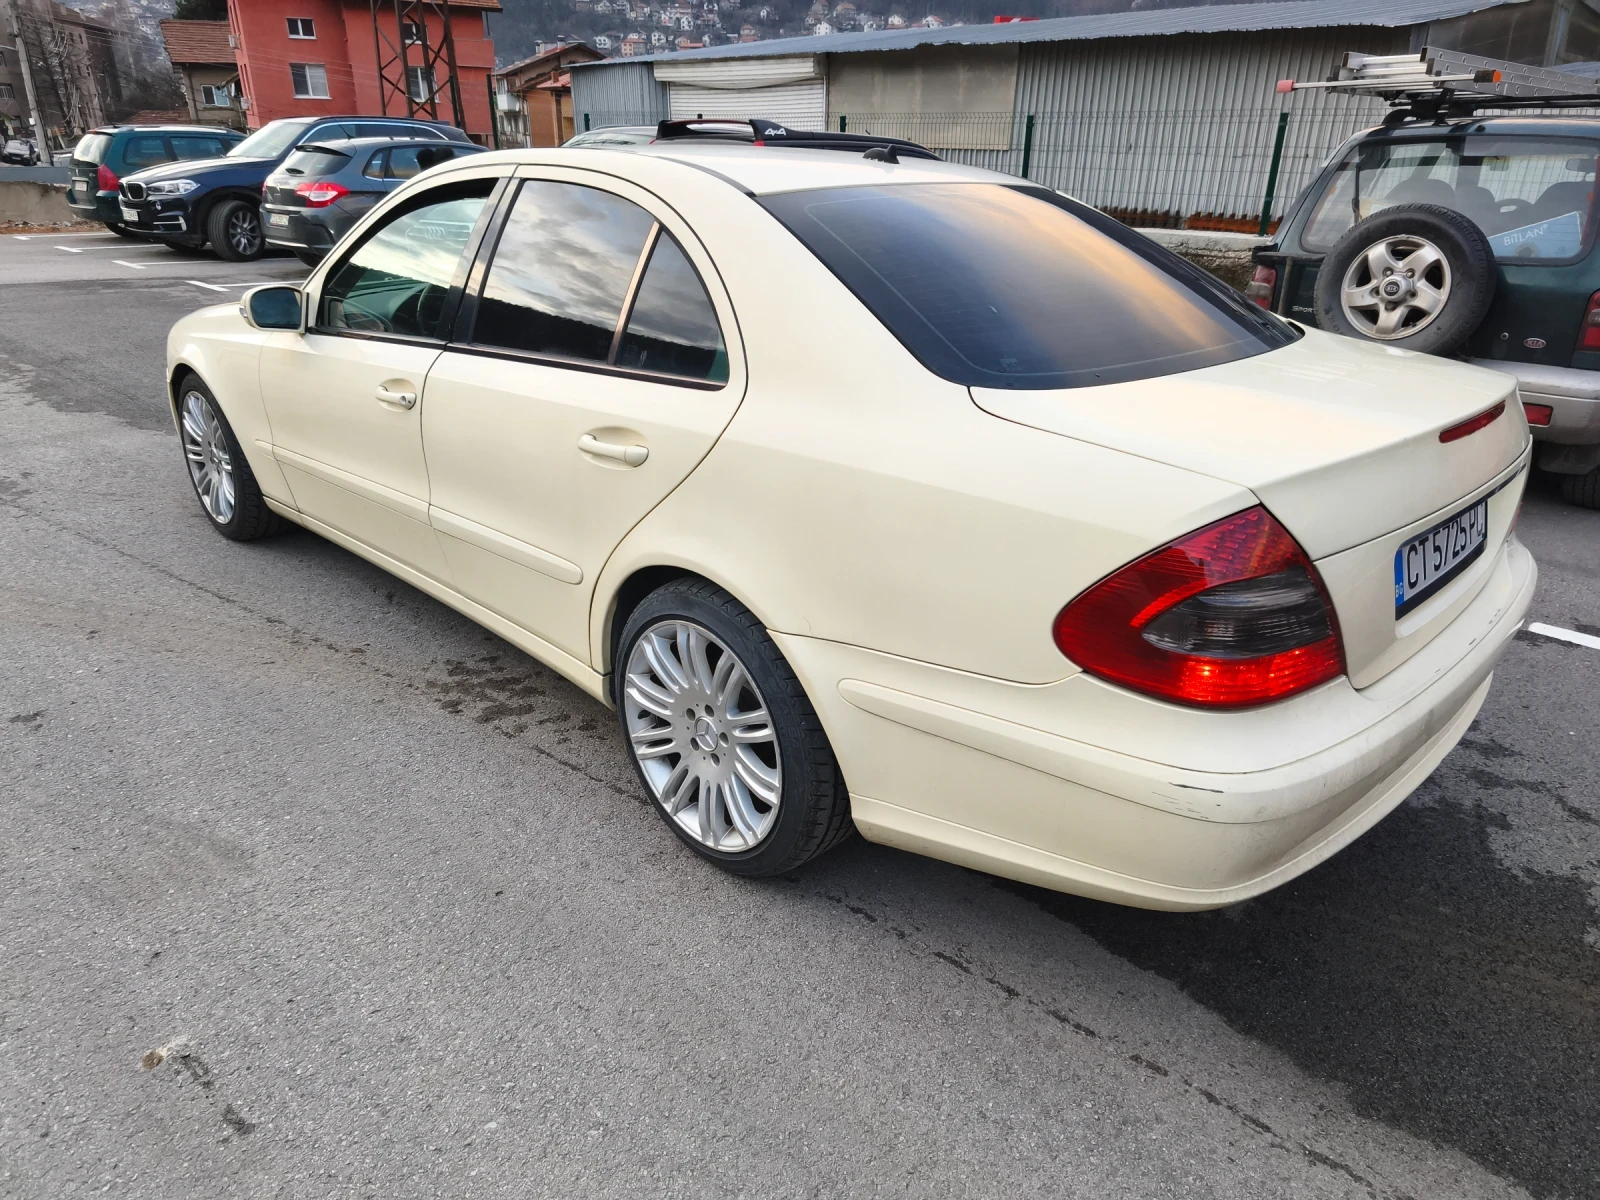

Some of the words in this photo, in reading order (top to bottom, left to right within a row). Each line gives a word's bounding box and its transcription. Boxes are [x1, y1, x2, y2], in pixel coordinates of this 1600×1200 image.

[764, 127, 787, 137] 4x4
[1527, 339, 1543, 348] KIA
[1407, 536, 1429, 589] CT
[1432, 518, 1467, 572] 5725
